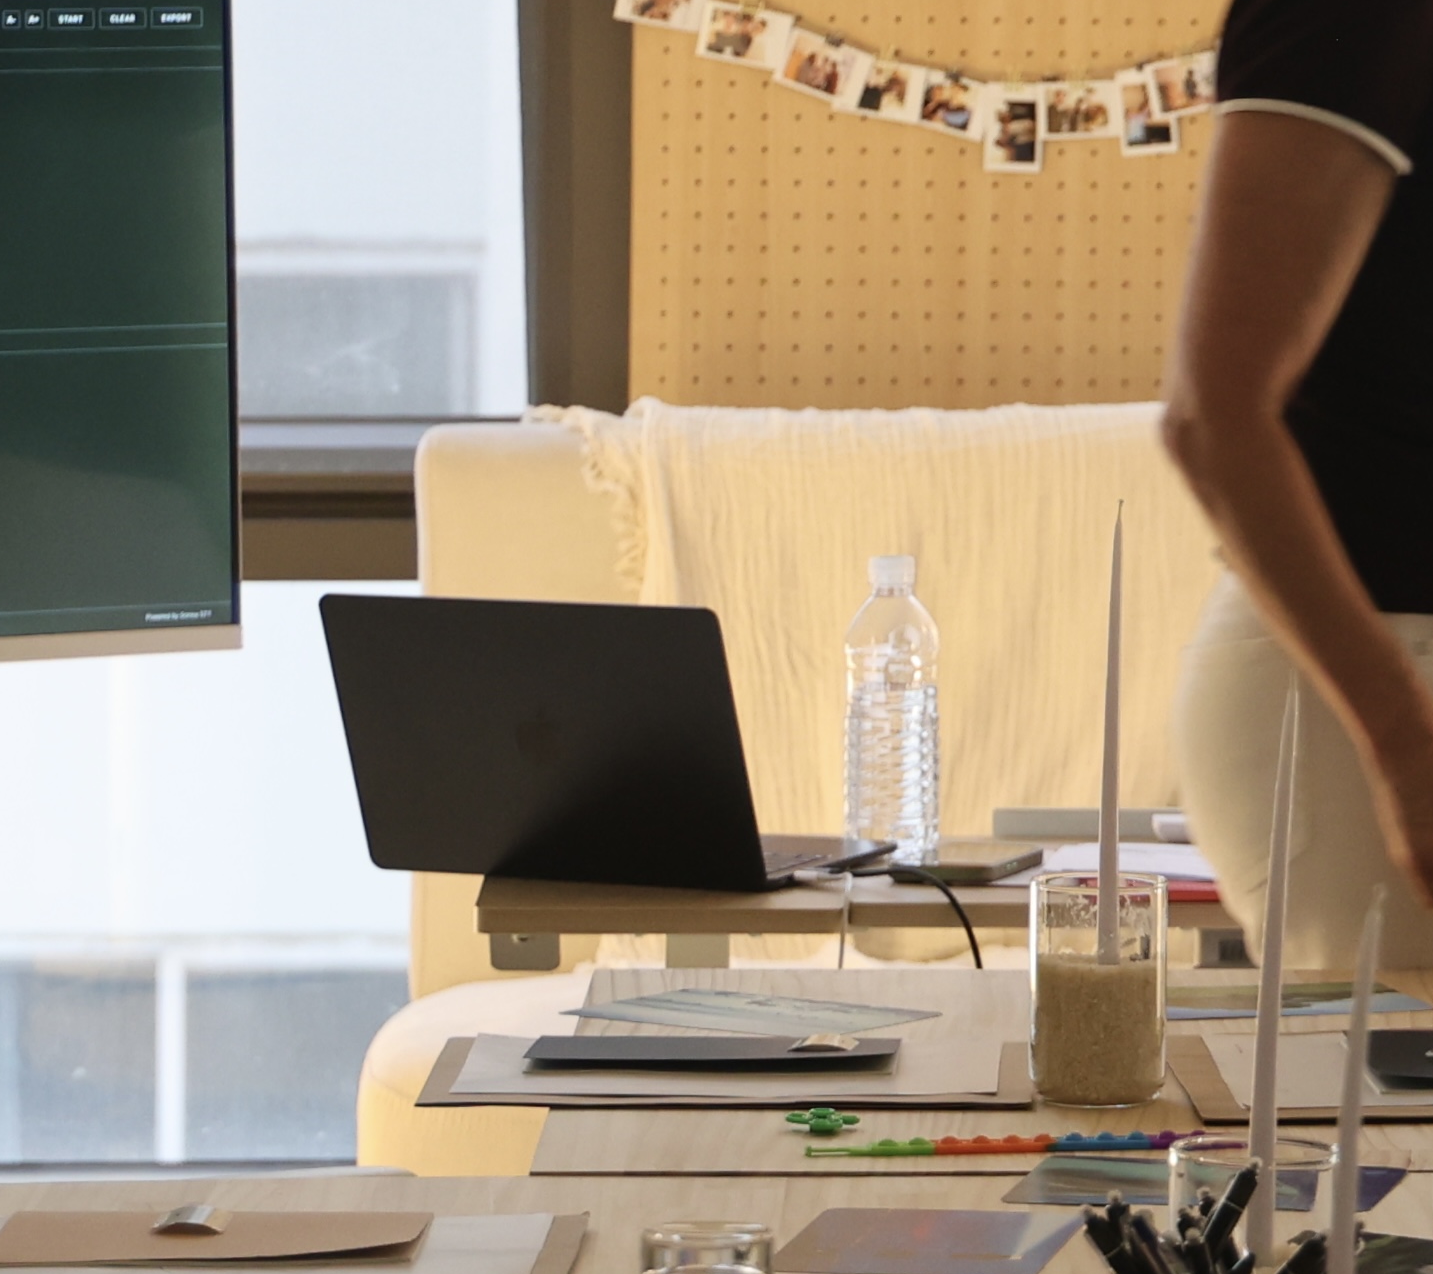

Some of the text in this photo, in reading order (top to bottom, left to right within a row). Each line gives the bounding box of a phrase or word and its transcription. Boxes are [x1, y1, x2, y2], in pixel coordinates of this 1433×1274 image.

[58, 14, 84, 24] START
[109, 13, 135, 24] CLEAR
[160, 13, 192, 23] EXPORT
